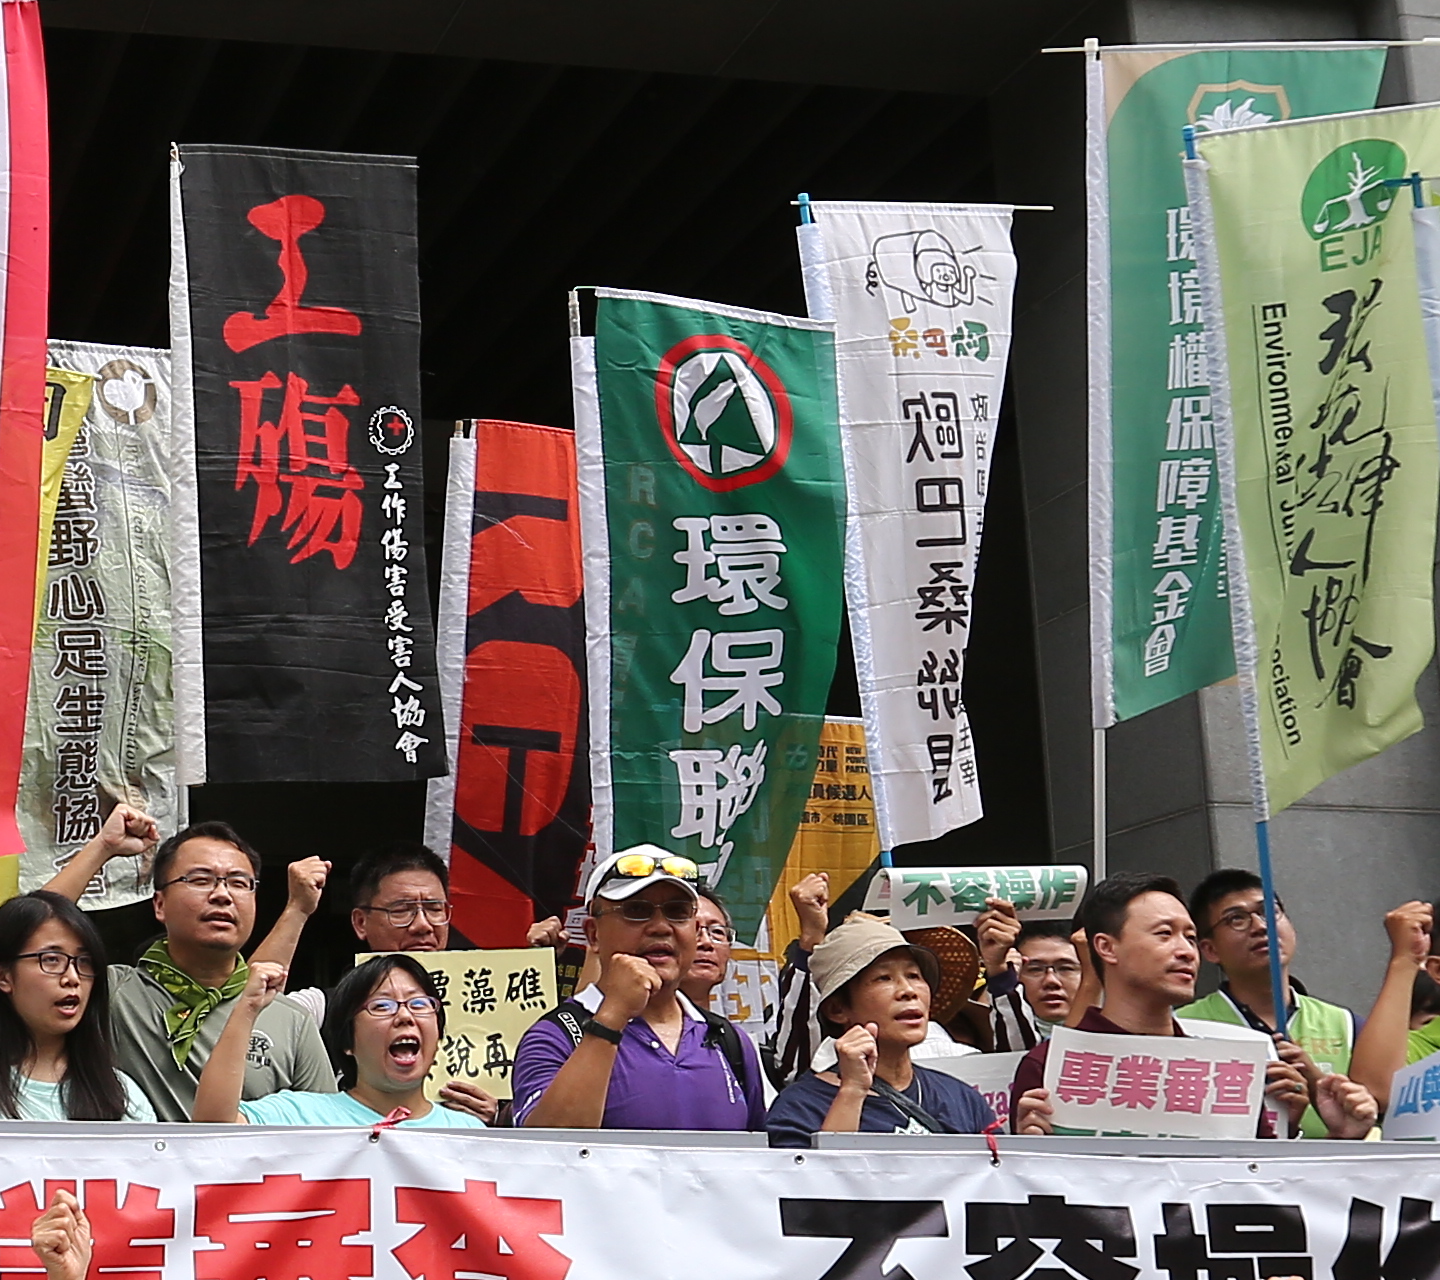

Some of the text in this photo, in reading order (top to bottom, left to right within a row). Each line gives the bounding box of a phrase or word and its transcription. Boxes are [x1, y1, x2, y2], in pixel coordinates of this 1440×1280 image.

[1319, 228, 1384, 273] EJA
[1142, 206, 1217, 679] 環境權保障基金會
[381, 462, 428, 763] 工作傷害受害人協會
[846, 756, 867, 764] POWE
[902, 869, 1078, 916] 不容操作
[1056, 1050, 1256, 1116] 專業審查
